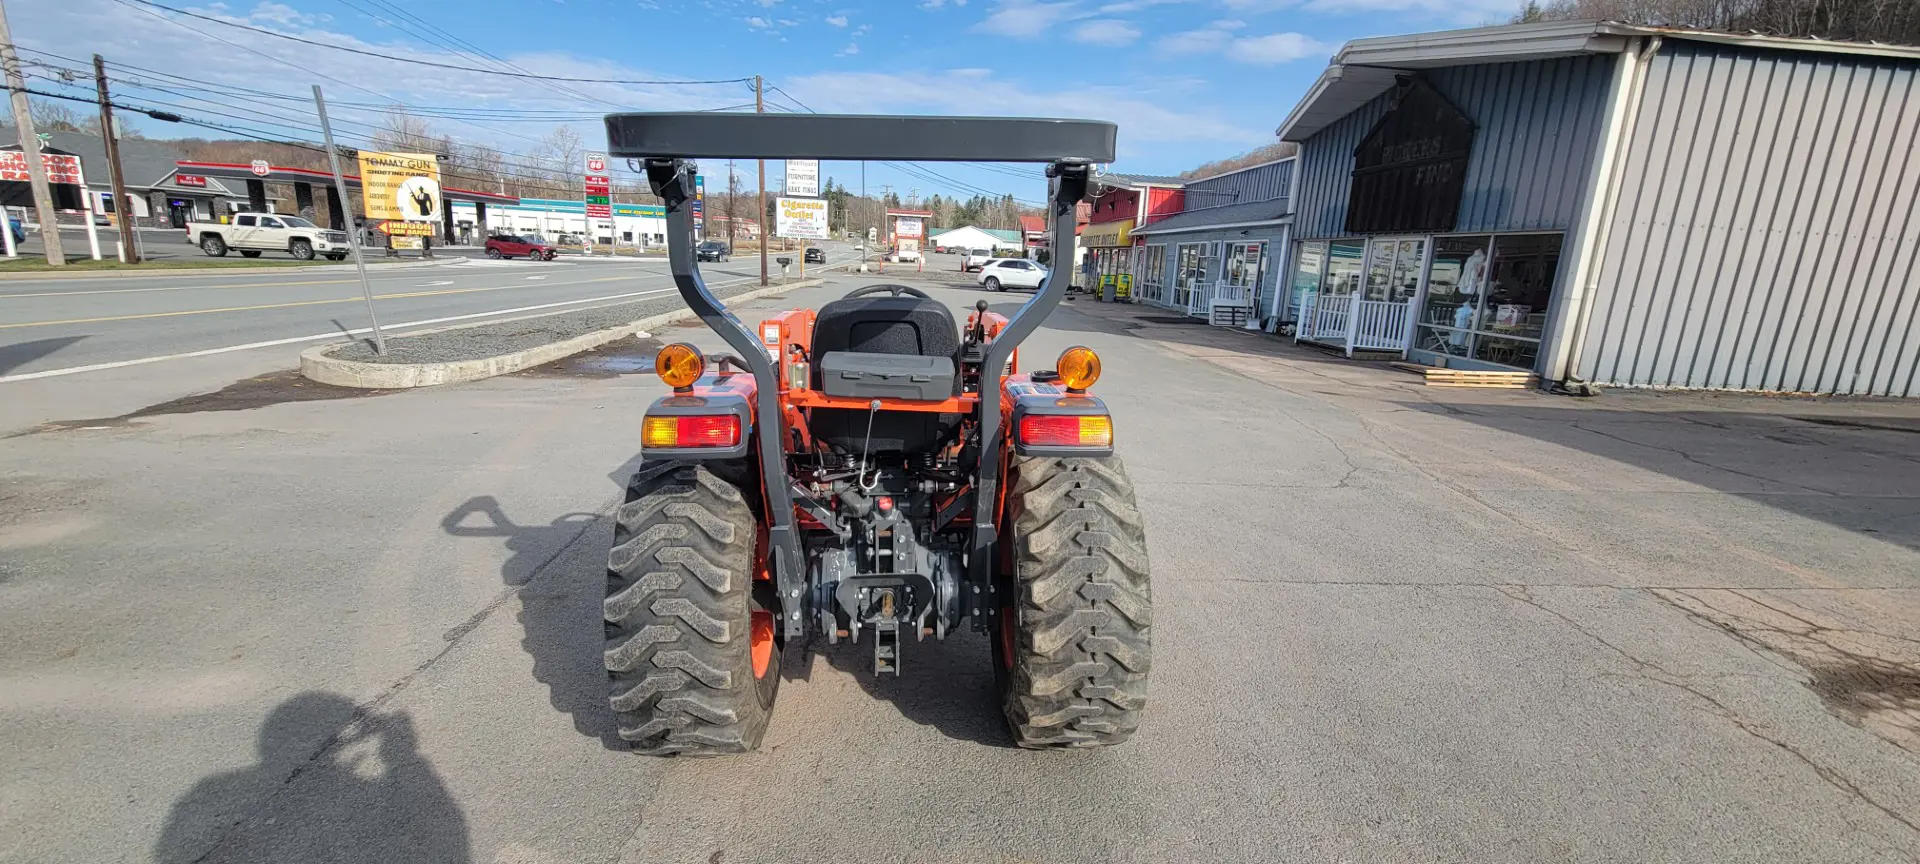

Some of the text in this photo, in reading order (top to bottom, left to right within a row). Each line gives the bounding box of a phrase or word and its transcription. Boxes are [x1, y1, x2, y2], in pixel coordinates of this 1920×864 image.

[365, 158, 431, 169] TOMMY GUN
[590, 161, 602, 169] 66
[2, 171, 80, 183] RAGE
[788, 173, 817, 181] FURNITURE
[781, 200, 824, 210] Cigarette
[784, 209, 813, 219] Outlet
